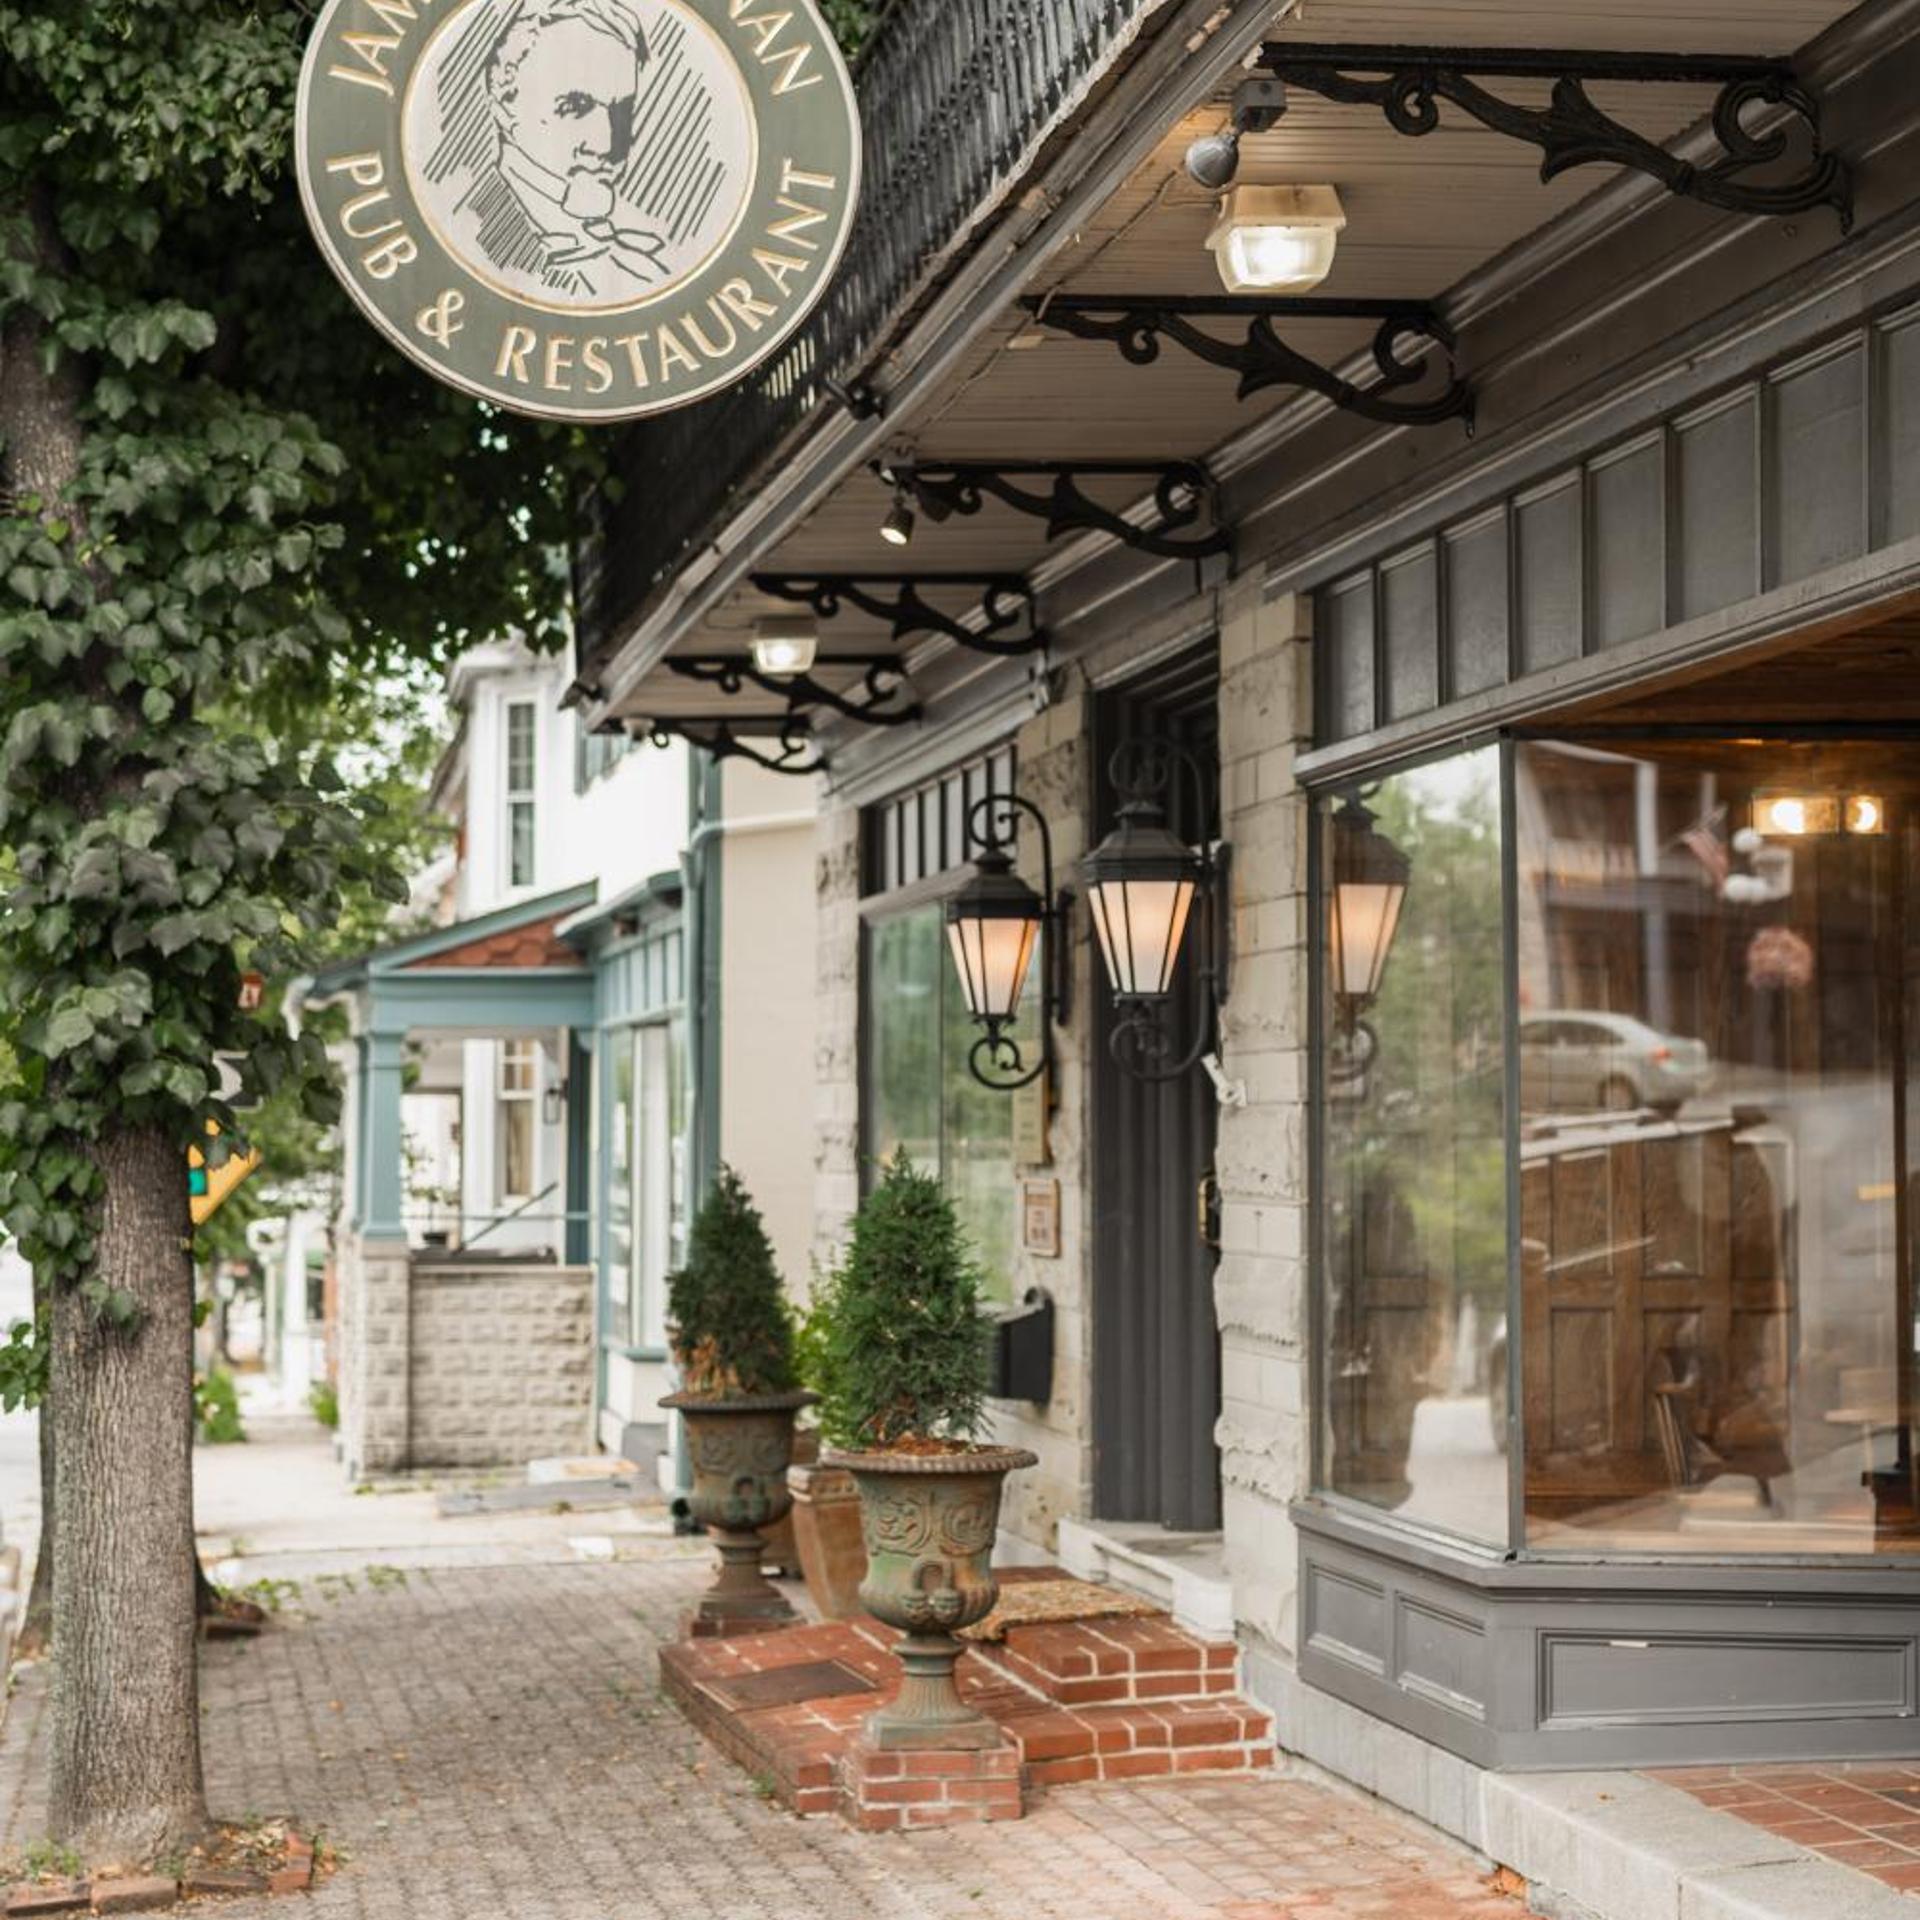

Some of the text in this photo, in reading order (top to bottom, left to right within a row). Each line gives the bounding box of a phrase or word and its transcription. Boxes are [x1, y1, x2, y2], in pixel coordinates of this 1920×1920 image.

[326, 150, 838, 394] PUB & RESTAURANT
